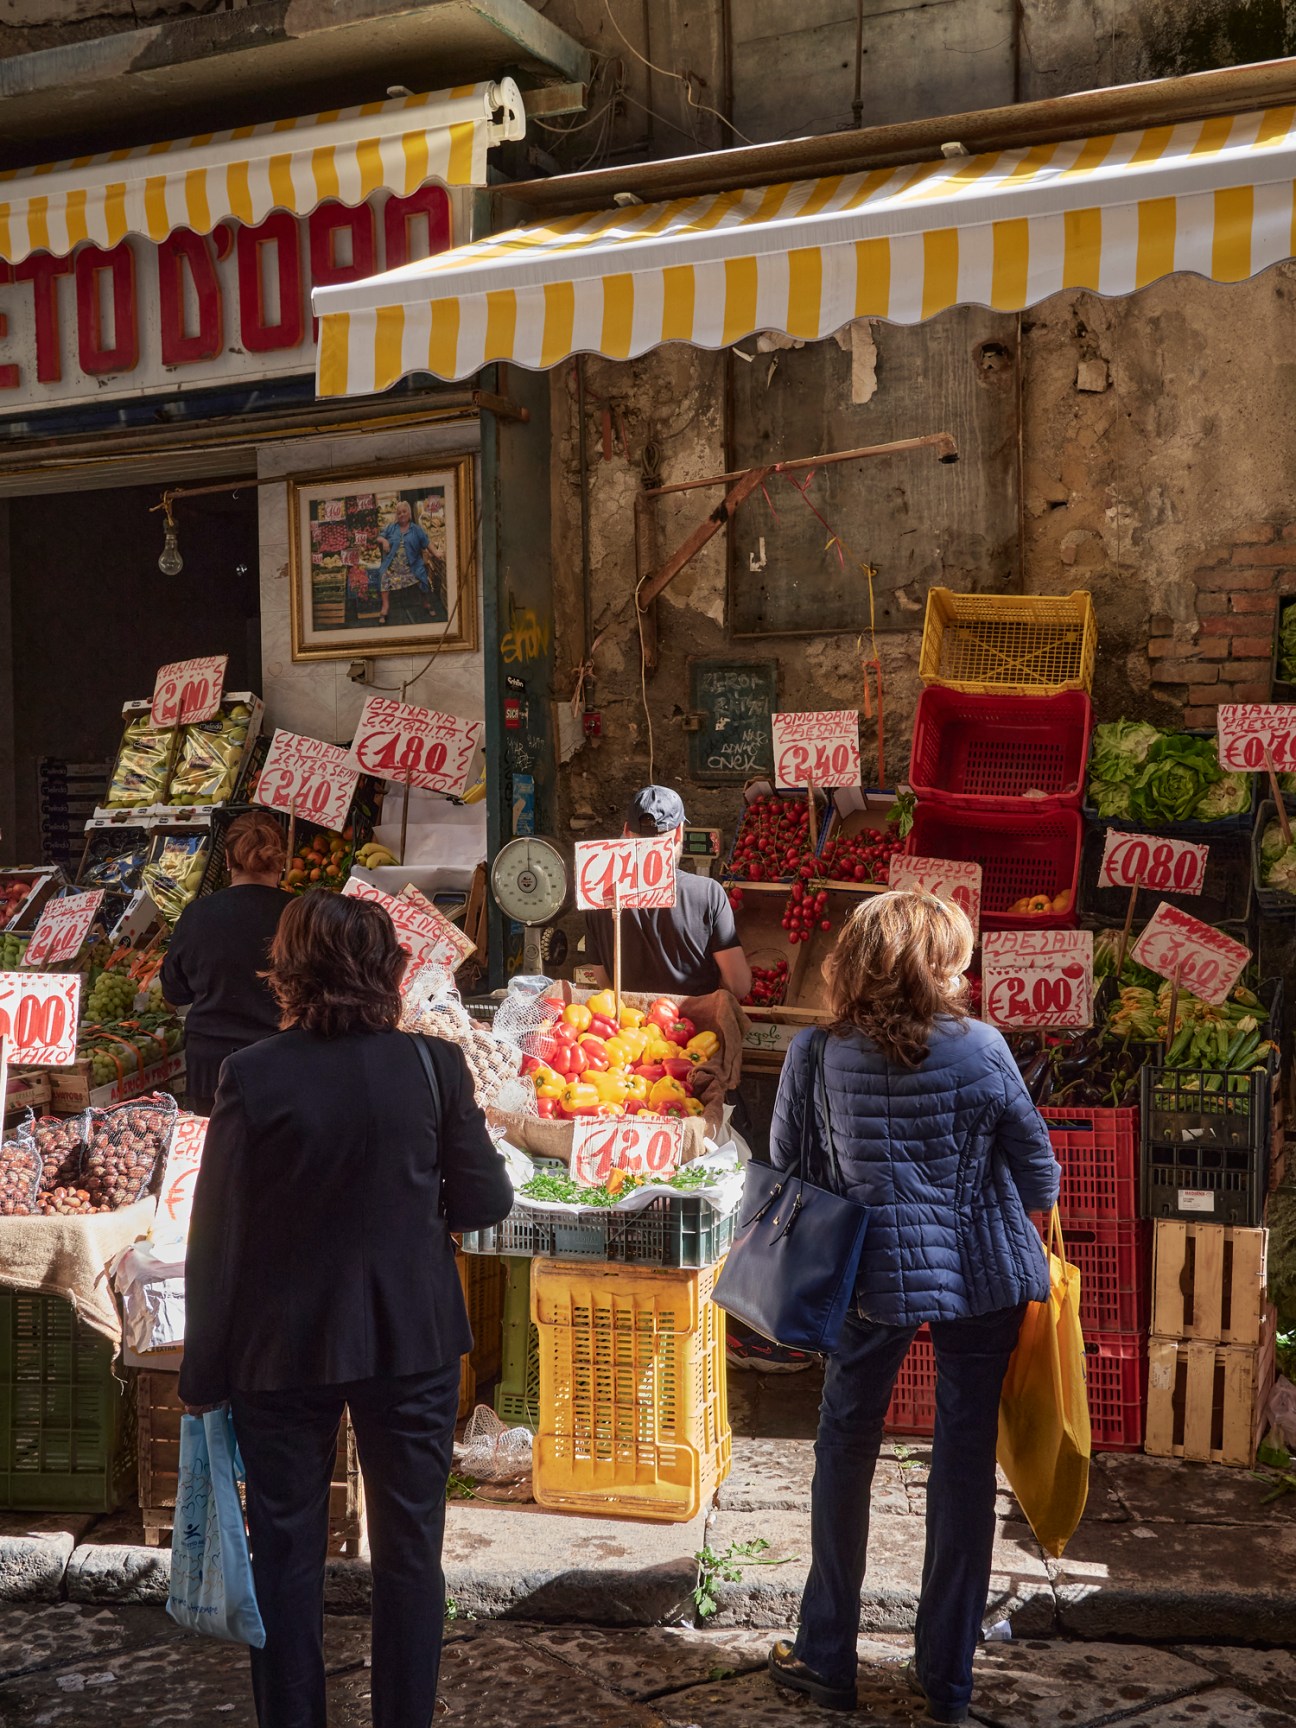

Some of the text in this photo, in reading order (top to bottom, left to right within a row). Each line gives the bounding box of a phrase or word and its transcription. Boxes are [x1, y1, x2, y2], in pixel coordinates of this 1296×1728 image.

[366, 697, 457, 726] BANANA
[392, 770, 446, 791] CHILO
[813, 774, 855, 787] CHILO
[984, 932, 1087, 951] PAESANI
[1023, 1012, 1077, 1026] CHILO
[7, 1051, 68, 1065] CHILO
